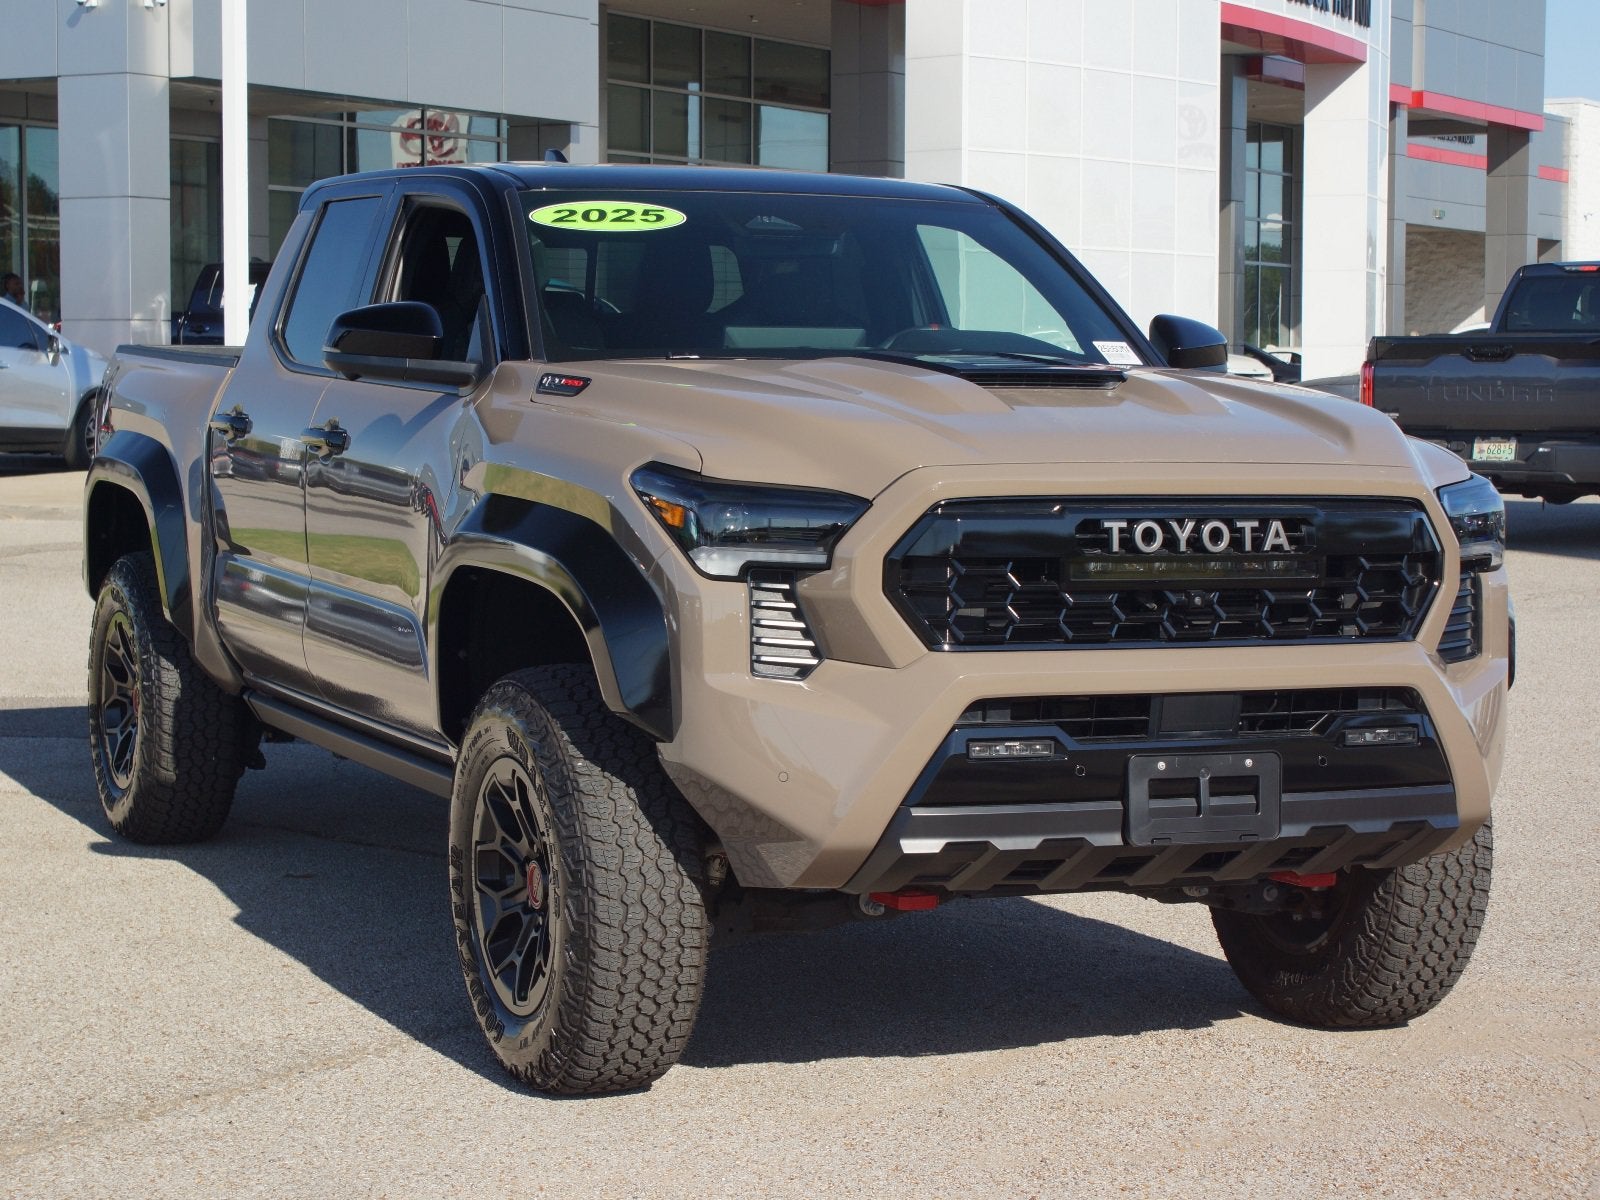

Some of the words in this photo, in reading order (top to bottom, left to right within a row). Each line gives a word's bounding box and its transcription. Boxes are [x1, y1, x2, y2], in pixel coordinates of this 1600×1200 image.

[551, 208, 665, 223] 2025
[1103, 519, 1291, 553] TOYOTA
[451, 844, 505, 1044] GOODYEAR
